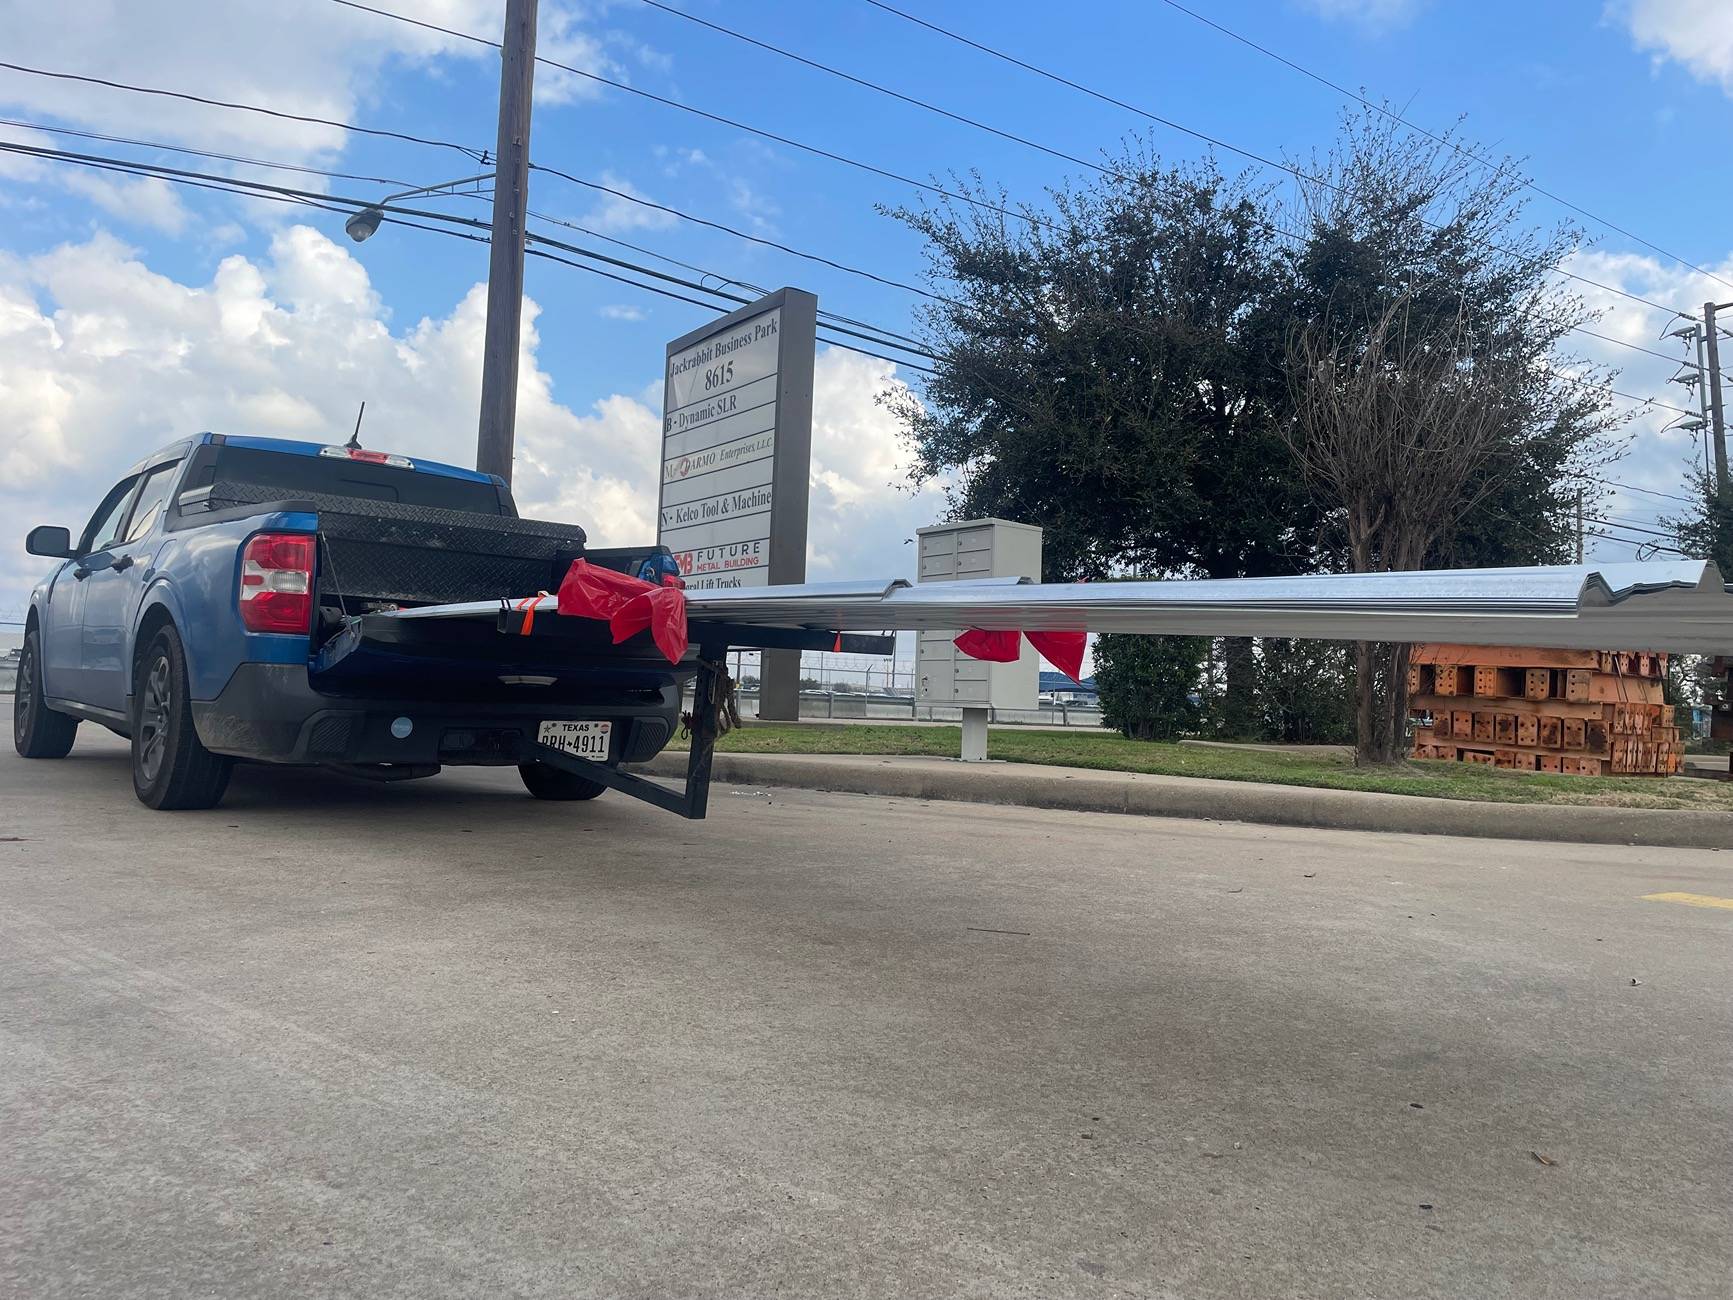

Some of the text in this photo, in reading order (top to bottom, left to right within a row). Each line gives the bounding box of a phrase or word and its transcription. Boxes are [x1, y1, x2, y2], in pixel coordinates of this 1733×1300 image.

[670, 318, 777, 377] Jackrabbit Business Park
[705, 360, 734, 391] 8615
[680, 404, 714, 430] Dynamic
[717, 395, 737, 415] SLR
[676, 508, 699, 524] Kelco
[701, 500, 719, 519] Tool
[721, 498, 729, 514] &
[732, 490, 772, 512] Machine
[697, 541, 761, 562] FUTURE
[696, 557, 759, 573] METAL BUILDING
[716, 576, 742, 589] Trucks
[562, 723, 590, 732] TEXAS
